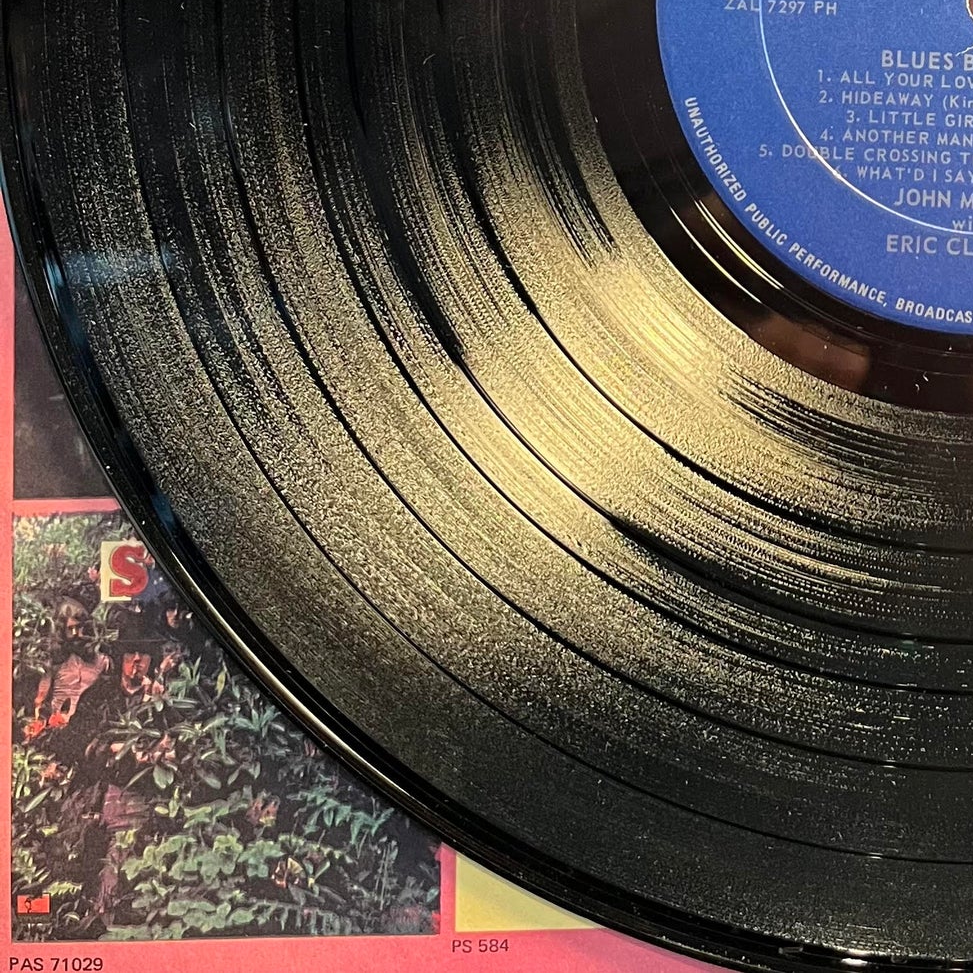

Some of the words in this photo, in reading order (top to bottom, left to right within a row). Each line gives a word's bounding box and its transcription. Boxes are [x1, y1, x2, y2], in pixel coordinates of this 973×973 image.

[767, 0, 806, 14] 7297
[813, 0, 838, 16] PH
[881, 50, 954, 70] BLUES
[817, 69, 832, 83] 1.
[840, 71, 876, 85] ALL
[884, 72, 934, 88] YOUR
[819, 91, 833, 104] 2.
[841, 91, 934, 108] HIDEAWAY
[846, 110, 860, 123] 3.
[869, 110, 936, 126] LITTLE
[820, 128, 834, 141] 4.
[842, 129, 930, 145] ANOTHER
[937, 132, 973, 147] MAN
[759, 144, 773, 157] 5.
[782, 145, 855, 161] DOUBLE
[864, 148, 951, 164] CROSSING
[857, 166, 925, 180] WHAT'D
[932, 169, 937, 182] I
[684, 97, 748, 202] UNAUTHORIZED
[745, 202, 788, 246] PUBLIC
[789, 242, 888, 307] PERFORMANCE,
[894, 188, 951, 208] JOHN
[886, 234, 938, 254] ERIC
[452, 939, 472, 953] PS
[478, 939, 509, 953] 584
[9, 957, 44, 971] PAS
[50, 957, 103, 971] 71029
